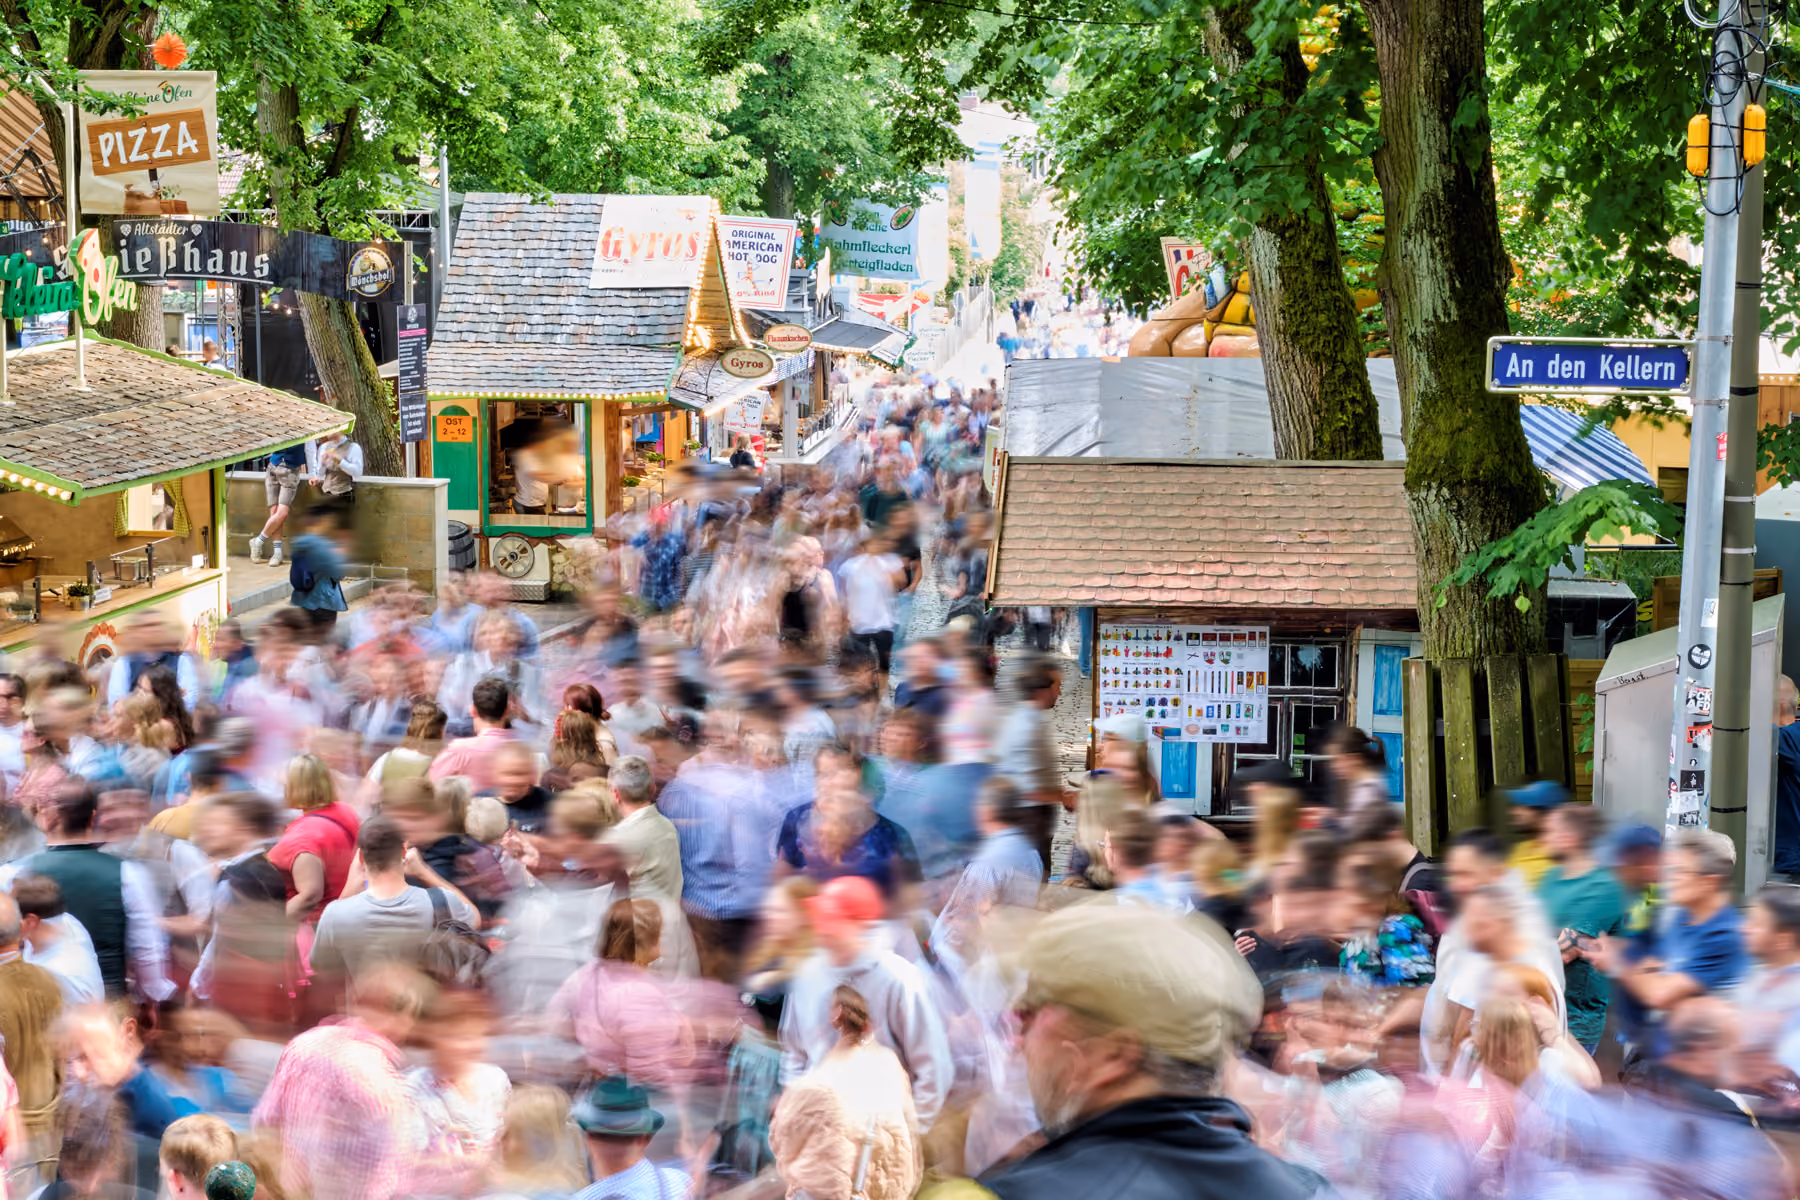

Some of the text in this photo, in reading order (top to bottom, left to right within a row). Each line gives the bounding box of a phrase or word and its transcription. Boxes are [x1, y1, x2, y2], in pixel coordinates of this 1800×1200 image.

[98, 121, 199, 167] PIZZA
[134, 222, 188, 236] Altstädter
[731, 229, 776, 240] ORIGINAL
[601, 226, 700, 263] Gyros
[725, 239, 783, 252] AMERICAN
[834, 239, 911, 255] ahmfleckerl
[728, 251, 777, 264] HOT DOG
[730, 358, 764, 369] Gyros
[1506, 352, 1676, 380] An den Kellern
[445, 417, 462, 426] OST
[443, 427, 448, 436] 2
[457, 427, 466, 436] 12
[1688, 690, 1711, 702] FCK
